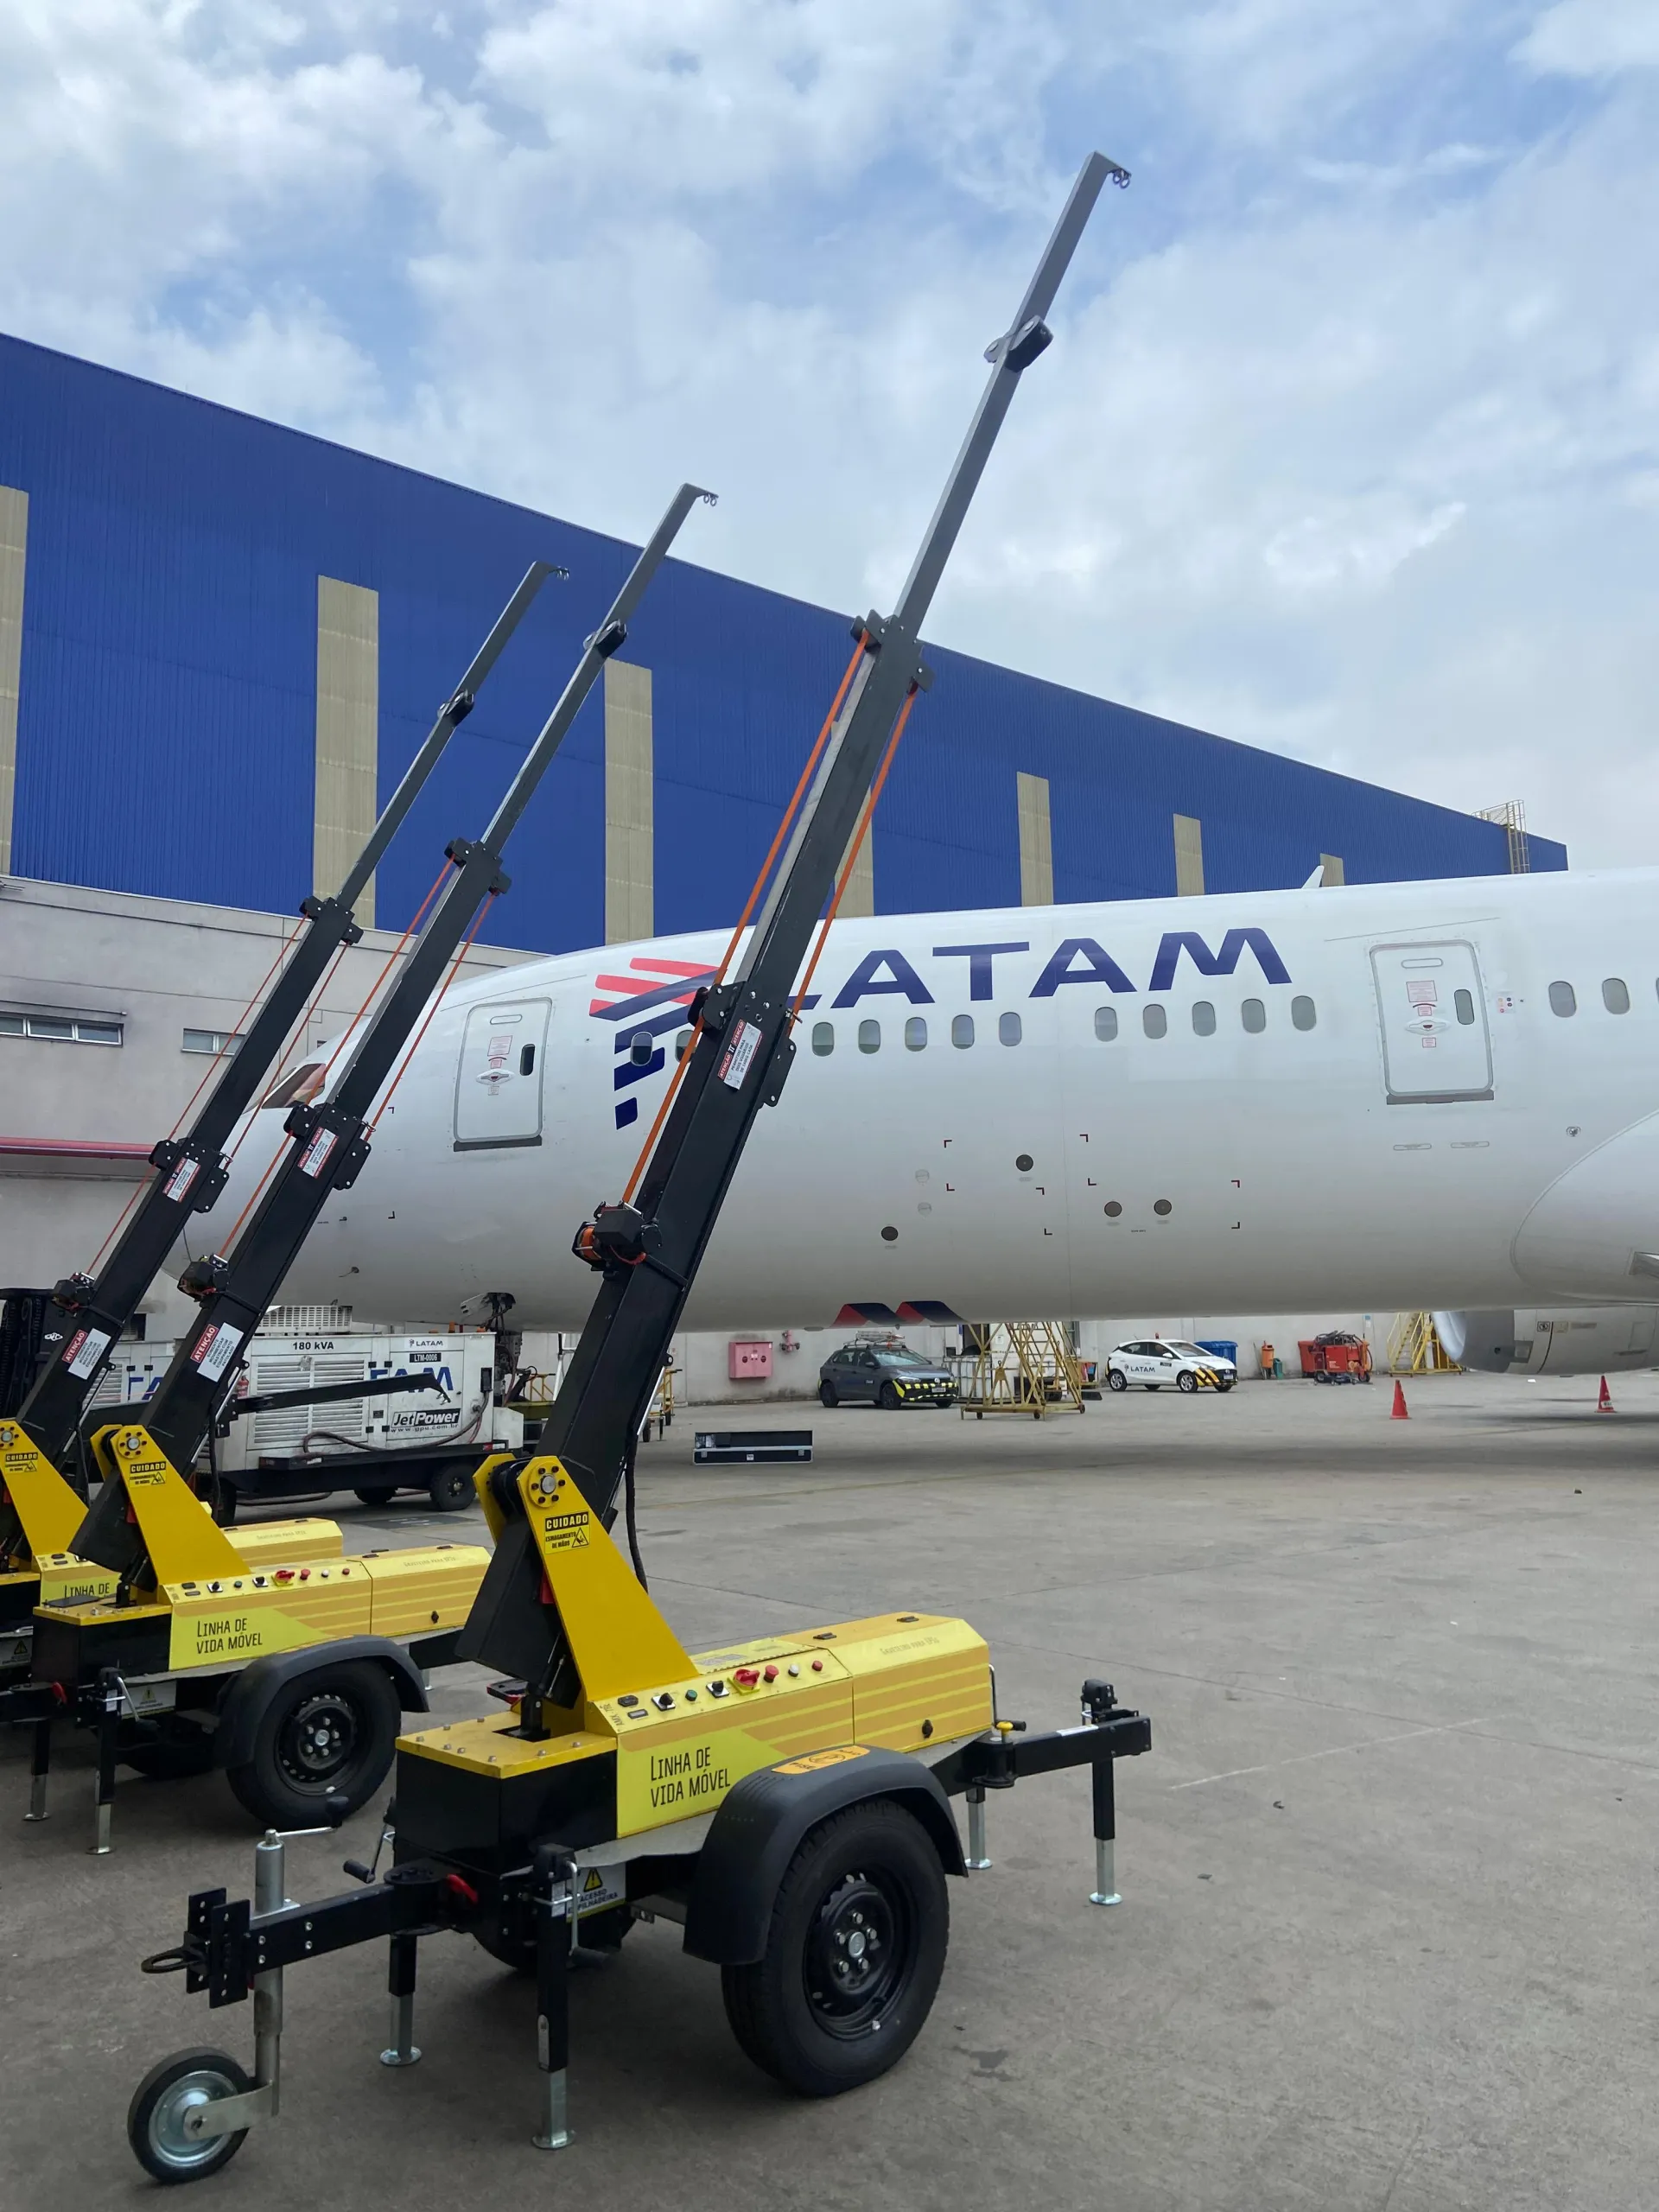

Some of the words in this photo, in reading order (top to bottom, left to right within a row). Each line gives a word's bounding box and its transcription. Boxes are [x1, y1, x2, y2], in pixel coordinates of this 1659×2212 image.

[194, 1327, 215, 1360] ATENÇÃO
[292, 1341, 311, 1351] 180
[315, 1340, 334, 1350] kVA
[393, 1412, 459, 1426] JetPower
[130, 1462, 165, 1472] CUIDADO
[546, 1514, 588, 1529] CUIDADO
[64, 1585, 95, 1599] LINHA
[98, 1582, 110, 1595] DE
[197, 1619, 231, 1637] LINHA
[234, 1618, 248, 1632] DE
[196, 1638, 224, 1655] VIDA
[228, 1631, 263, 1650] MÓVEL
[650, 1755, 691, 1781] LINHA
[696, 1746, 710, 1769] DE
[650, 1781, 684, 1808] VIDA
[689, 1768, 731, 1797] MÓVEL
